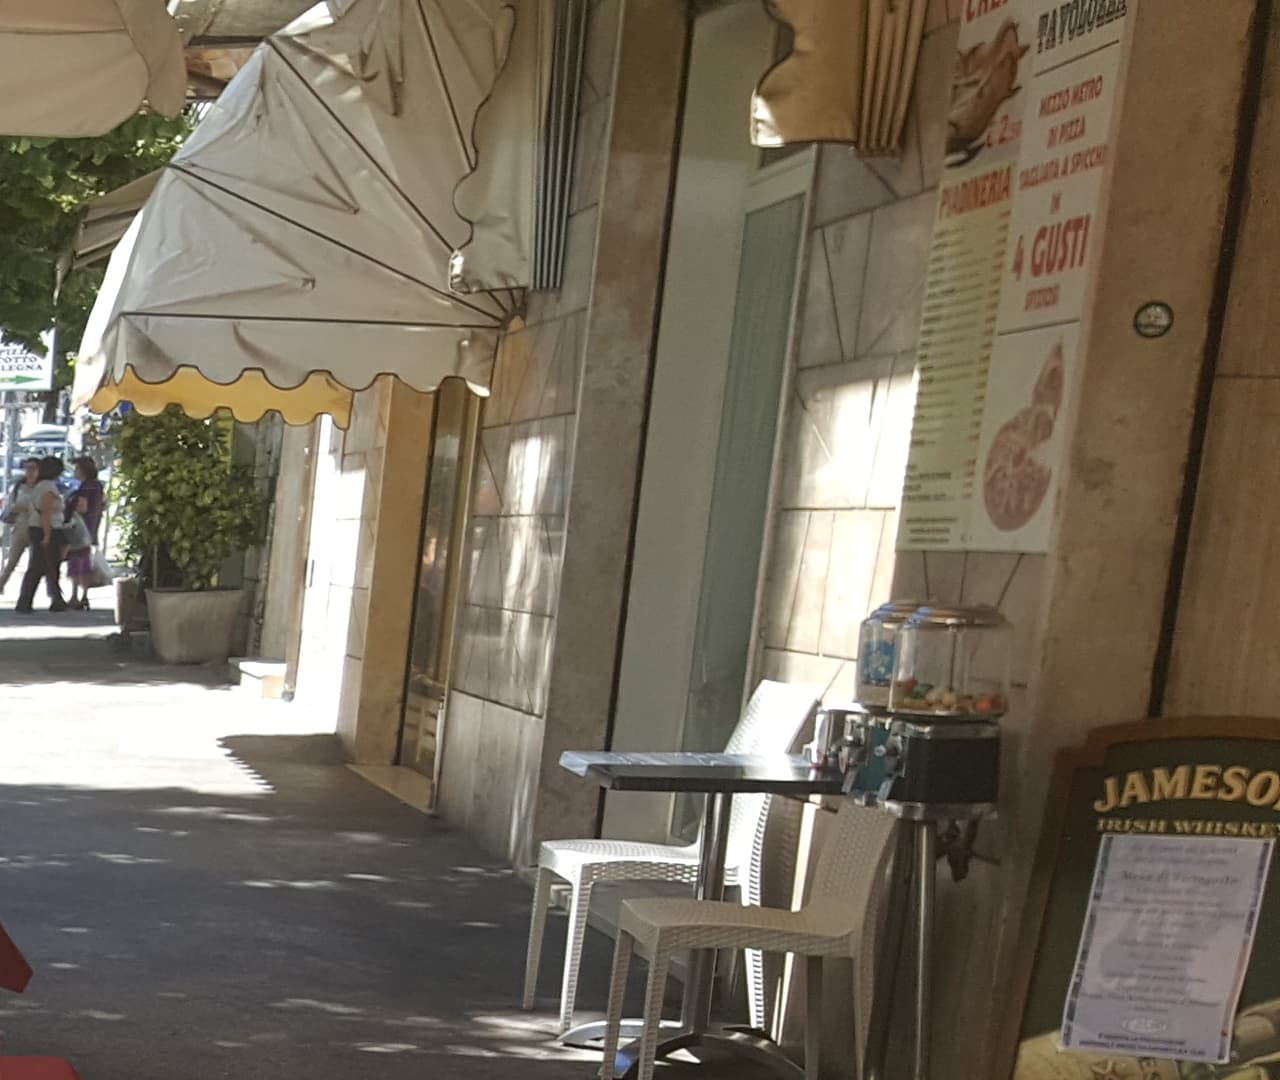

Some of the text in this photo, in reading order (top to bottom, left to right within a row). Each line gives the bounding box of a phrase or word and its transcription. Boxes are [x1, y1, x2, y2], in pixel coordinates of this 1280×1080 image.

[1071, 75, 1103, 106] METRO
[1058, 116, 1085, 144] PIZZA
[1012, 213, 1092, 281] 4 GUSTI
[1, 364, 43, 372] LEGNA
[1093, 764, 1280, 813] JAMESO
[1096, 818, 1167, 833] IRISH
